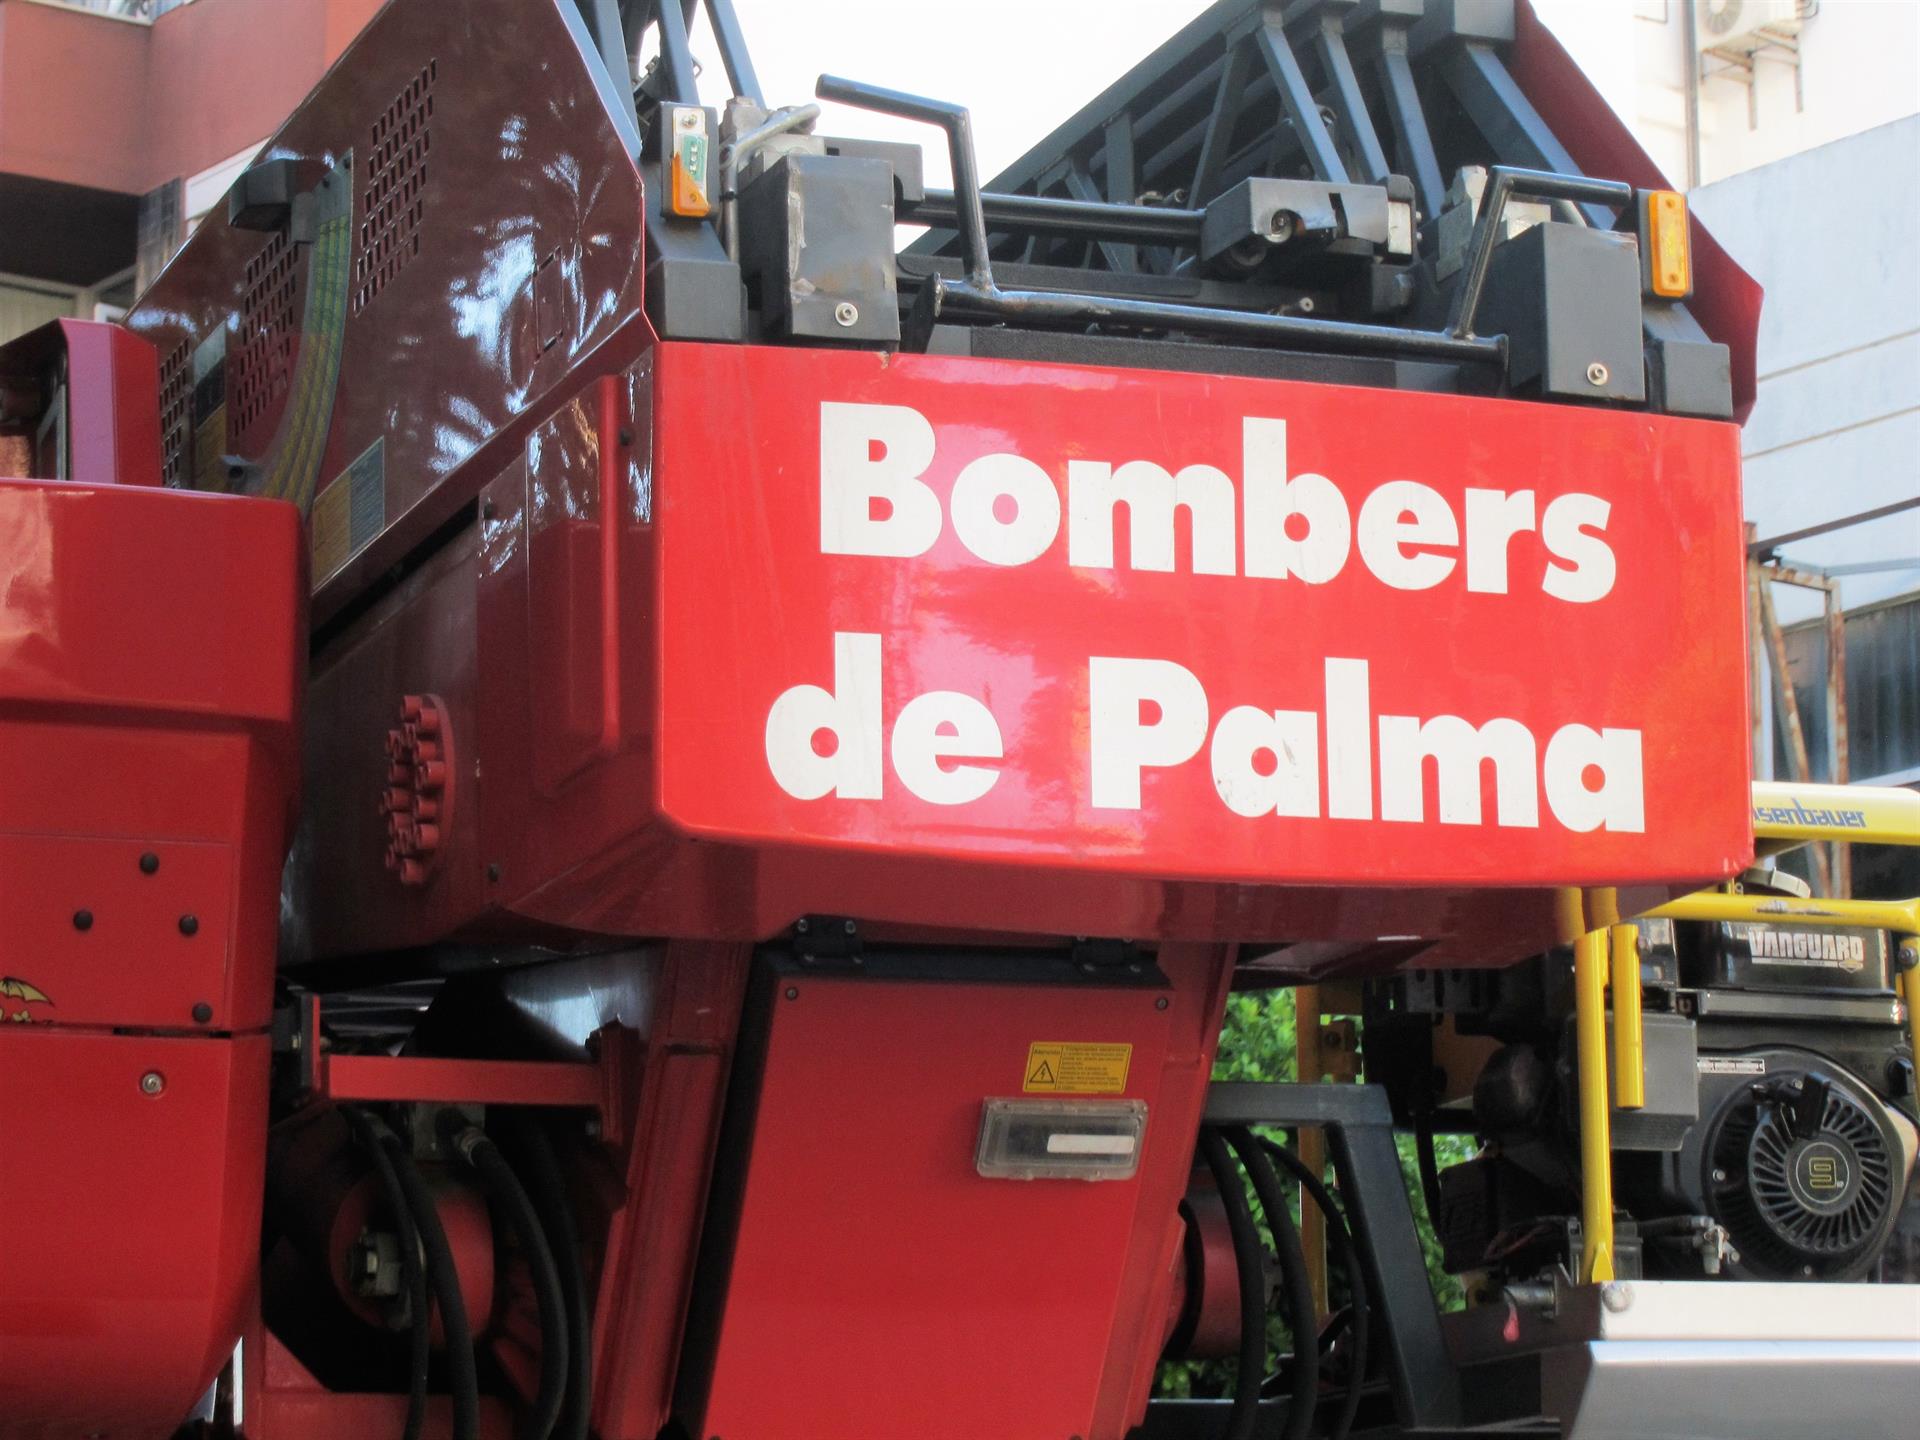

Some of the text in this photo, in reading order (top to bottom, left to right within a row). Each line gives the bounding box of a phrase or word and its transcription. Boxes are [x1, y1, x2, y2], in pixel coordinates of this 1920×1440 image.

[820, 402, 1616, 604] Bombers
[766, 633, 1645, 834] de Palma
[1748, 928, 1864, 961] VANGUARD
